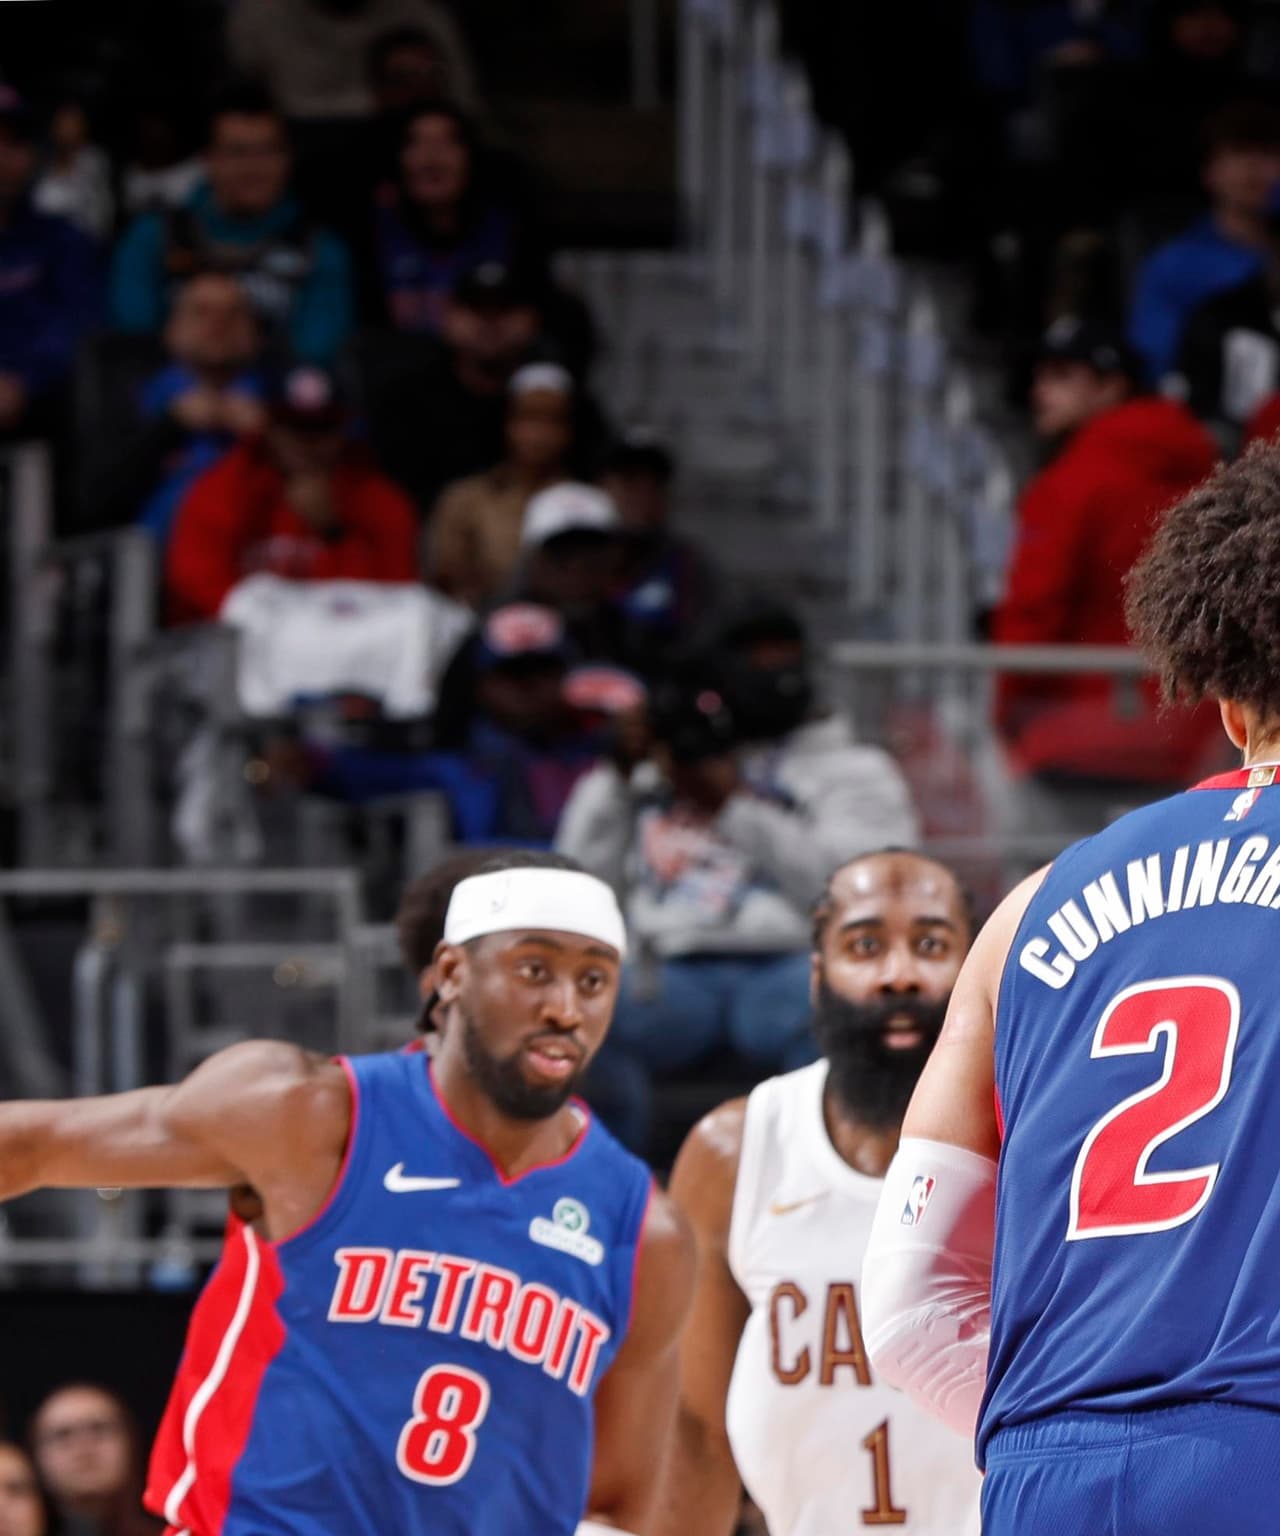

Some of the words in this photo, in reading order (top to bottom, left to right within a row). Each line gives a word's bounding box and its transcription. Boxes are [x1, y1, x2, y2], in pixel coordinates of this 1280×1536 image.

[1066, 975, 1241, 1241] 2
[327, 1247, 610, 1397] DETROIT
[768, 1281, 873, 1387] CA
[396, 1363, 490, 1486] 8
[861, 1416, 907, 1525] 1
